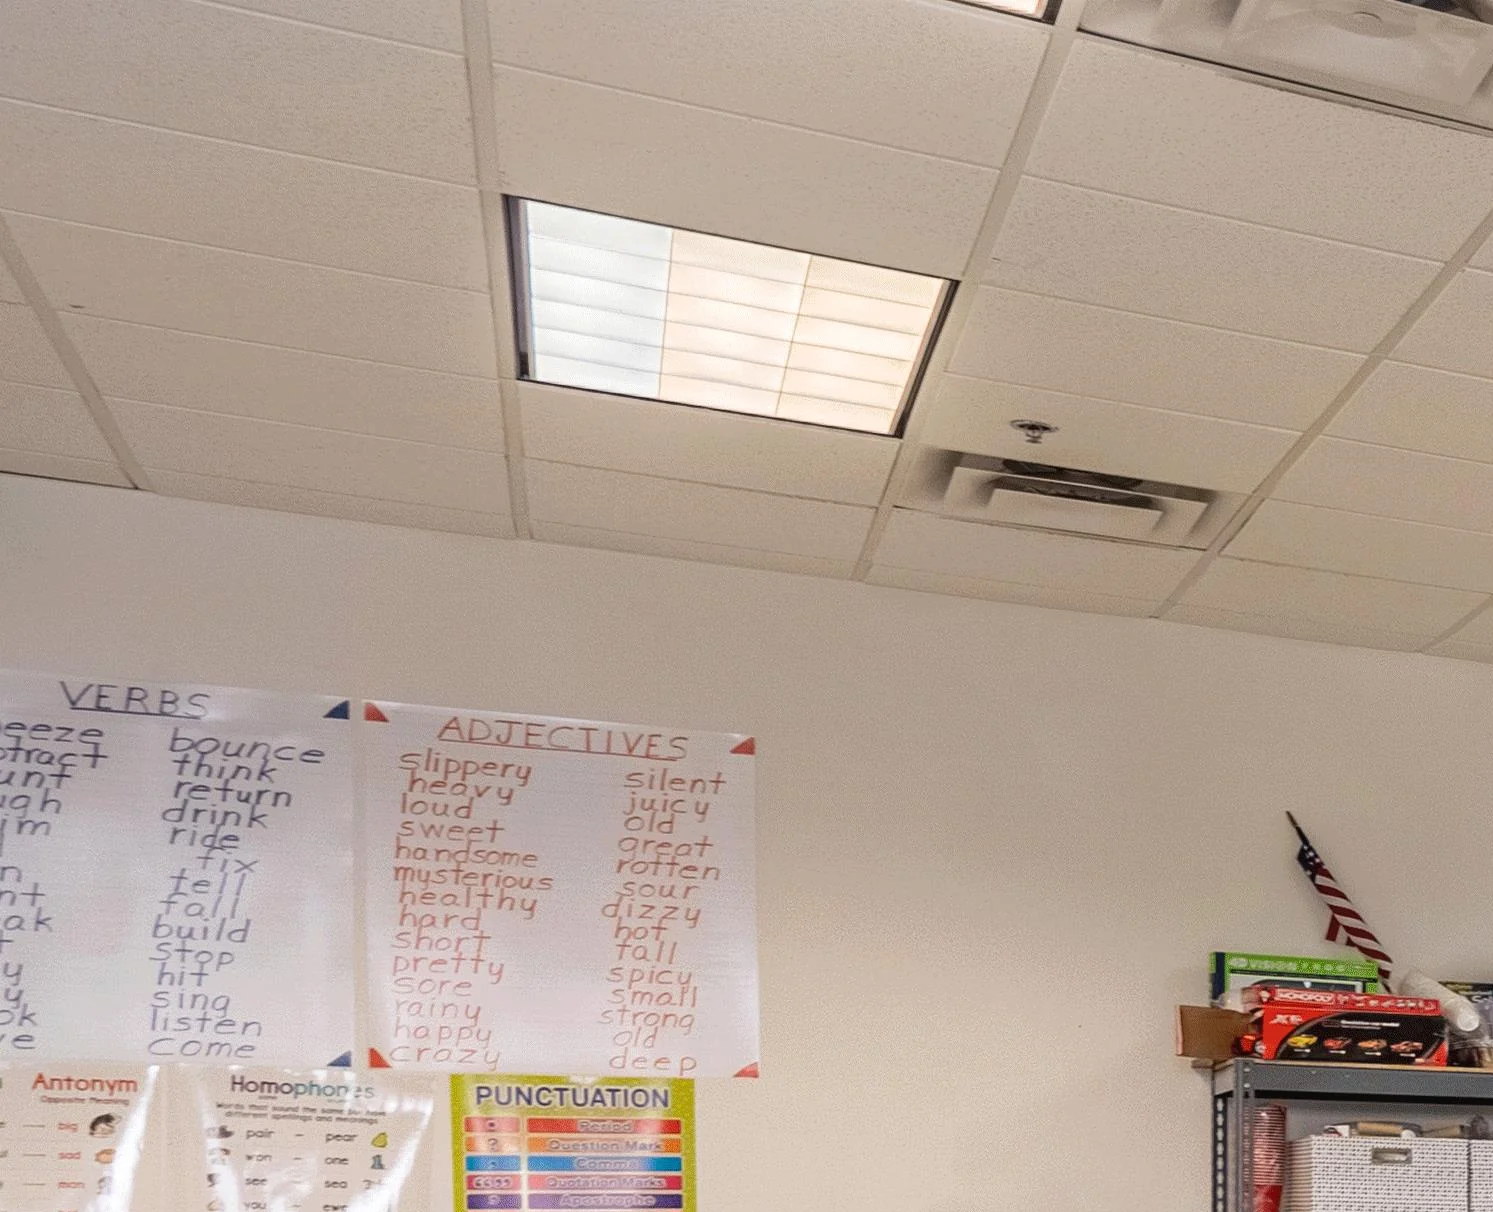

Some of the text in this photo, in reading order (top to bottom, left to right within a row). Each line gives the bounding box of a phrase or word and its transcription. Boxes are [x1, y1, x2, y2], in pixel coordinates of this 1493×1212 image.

[60, 681, 211, 717] VERBS
[169, 727, 325, 763] bounce
[438, 716, 690, 760] ADJECTIVES
[173, 754, 277, 783] think
[398, 747, 532, 787] slippery
[173, 780, 291, 806] return
[407, 768, 515, 806] heavy
[623, 768, 728, 794] silent
[162, 799, 268, 828] drink
[400, 793, 475, 819] loud
[623, 790, 710, 822] juicy
[398, 819, 505, 843] sweet
[623, 811, 676, 834] old
[169, 824, 241, 849] ride
[618, 835, 714, 862] great
[197, 848, 259, 873] fix
[394, 835, 538, 868] handsome
[392, 862, 554, 891] mysterious
[615, 854, 722, 881] rotten
[170, 868, 247, 895] tell
[616, 880, 701, 900] sour
[160, 893, 240, 918] fall
[399, 887, 538, 919] healthy
[601, 891, 702, 928] dizzy
[152, 913, 251, 943] build
[399, 907, 483, 930] hard
[614, 919, 668, 941] hot
[391, 926, 492, 953] short
[617, 941, 678, 965] tall
[157, 962, 209, 987] hit
[391, 952, 504, 985] pretty
[606, 965, 694, 990] spicy
[392, 977, 473, 997] sore
[607, 985, 699, 1008] small
[151, 988, 231, 1017] sing
[394, 998, 482, 1026] rainy
[150, 1006, 263, 1037] listen
[393, 1018, 492, 1045] happy
[598, 1006, 695, 1036] strong
[613, 1027, 660, 1049] old
[389, 1047, 501, 1071] crazy
[608, 1047, 698, 1077] deep
[31, 1072, 138, 1095] Antonym
[475, 1086, 669, 1108] PUNCTUATION
[550, 1140, 662, 1152] Question Mark
[548, 1177, 665, 1188] Quotation Marks
